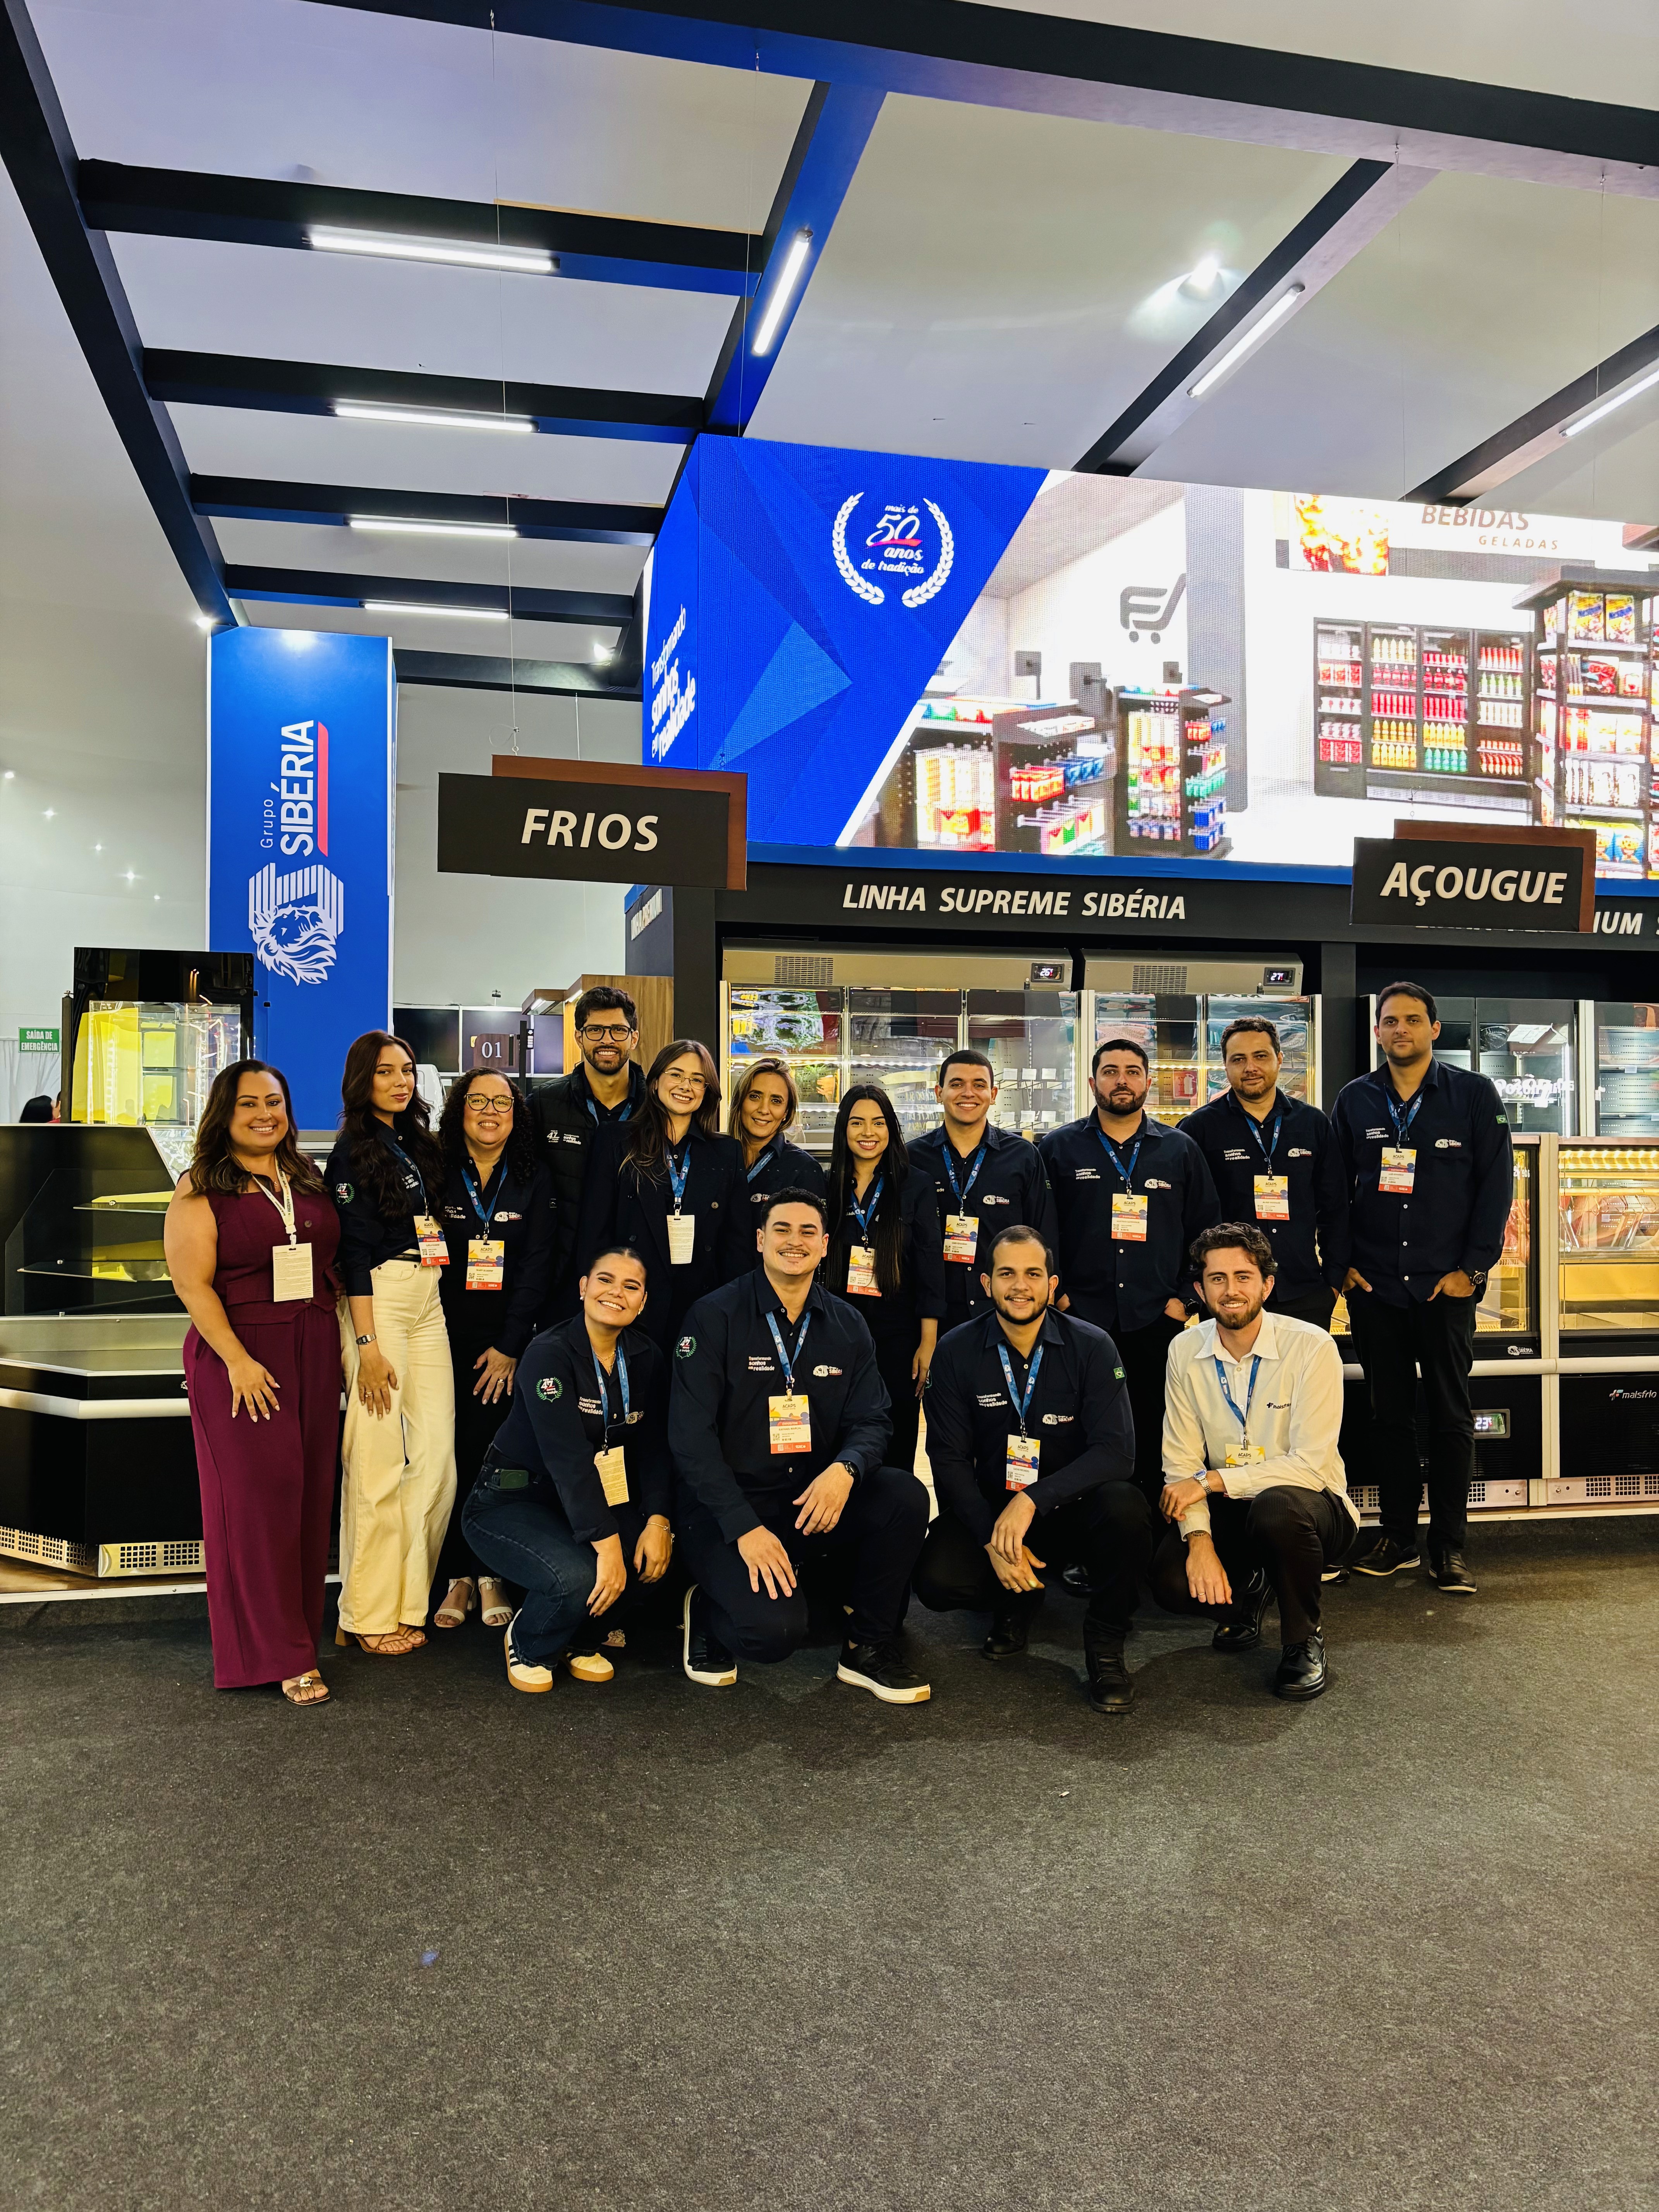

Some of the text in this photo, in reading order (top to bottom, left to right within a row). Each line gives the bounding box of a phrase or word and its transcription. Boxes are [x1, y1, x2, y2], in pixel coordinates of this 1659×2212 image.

[884, 504, 919, 514] mais de
[1421, 505, 1530, 531] BEBIDAS
[866, 514, 920, 547] 50
[1479, 534, 1559, 550] GELADAS
[861, 558, 924, 577] de tradição
[884, 547, 924, 561] anos
[651, 657, 679, 733] sonhos
[658, 670, 696, 763] realidade
[271, 720, 314, 857] SIBÉRIA
[260, 798, 276, 848] Grupo
[521, 808, 659, 852] FRIOS
[1379, 862, 1568, 907] AÇOUGUE
[842, 884, 1186, 920] LINHA SUPREME SIBÉRIA
[21, 1040, 58, 1051] EMERGÊNCIA
[26, 1030, 53, 1040] SAÍDA DE
[481, 1041, 502, 1058] 01
